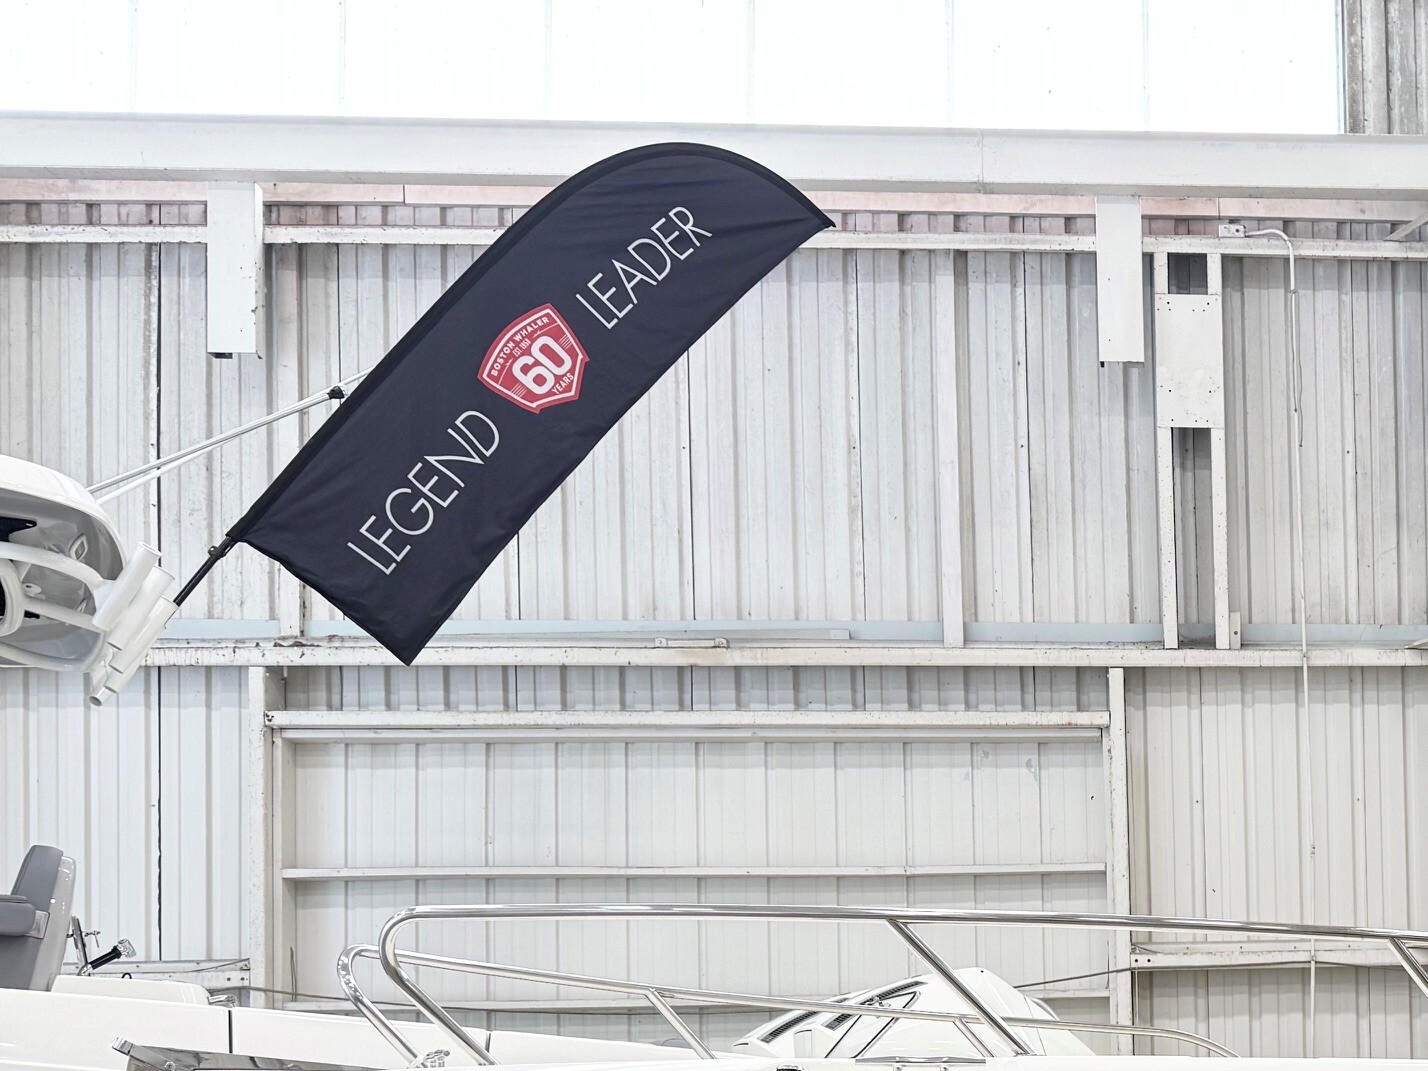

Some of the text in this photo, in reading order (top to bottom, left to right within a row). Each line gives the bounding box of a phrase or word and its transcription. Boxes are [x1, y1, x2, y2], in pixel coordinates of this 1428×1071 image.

[575, 206, 713, 330] LEADER
[490, 316, 549, 377] BOSTON WHALER
[512, 336, 572, 394] 60
[551, 372, 574, 395] YEARS
[347, 410, 500, 575] LEGEND
